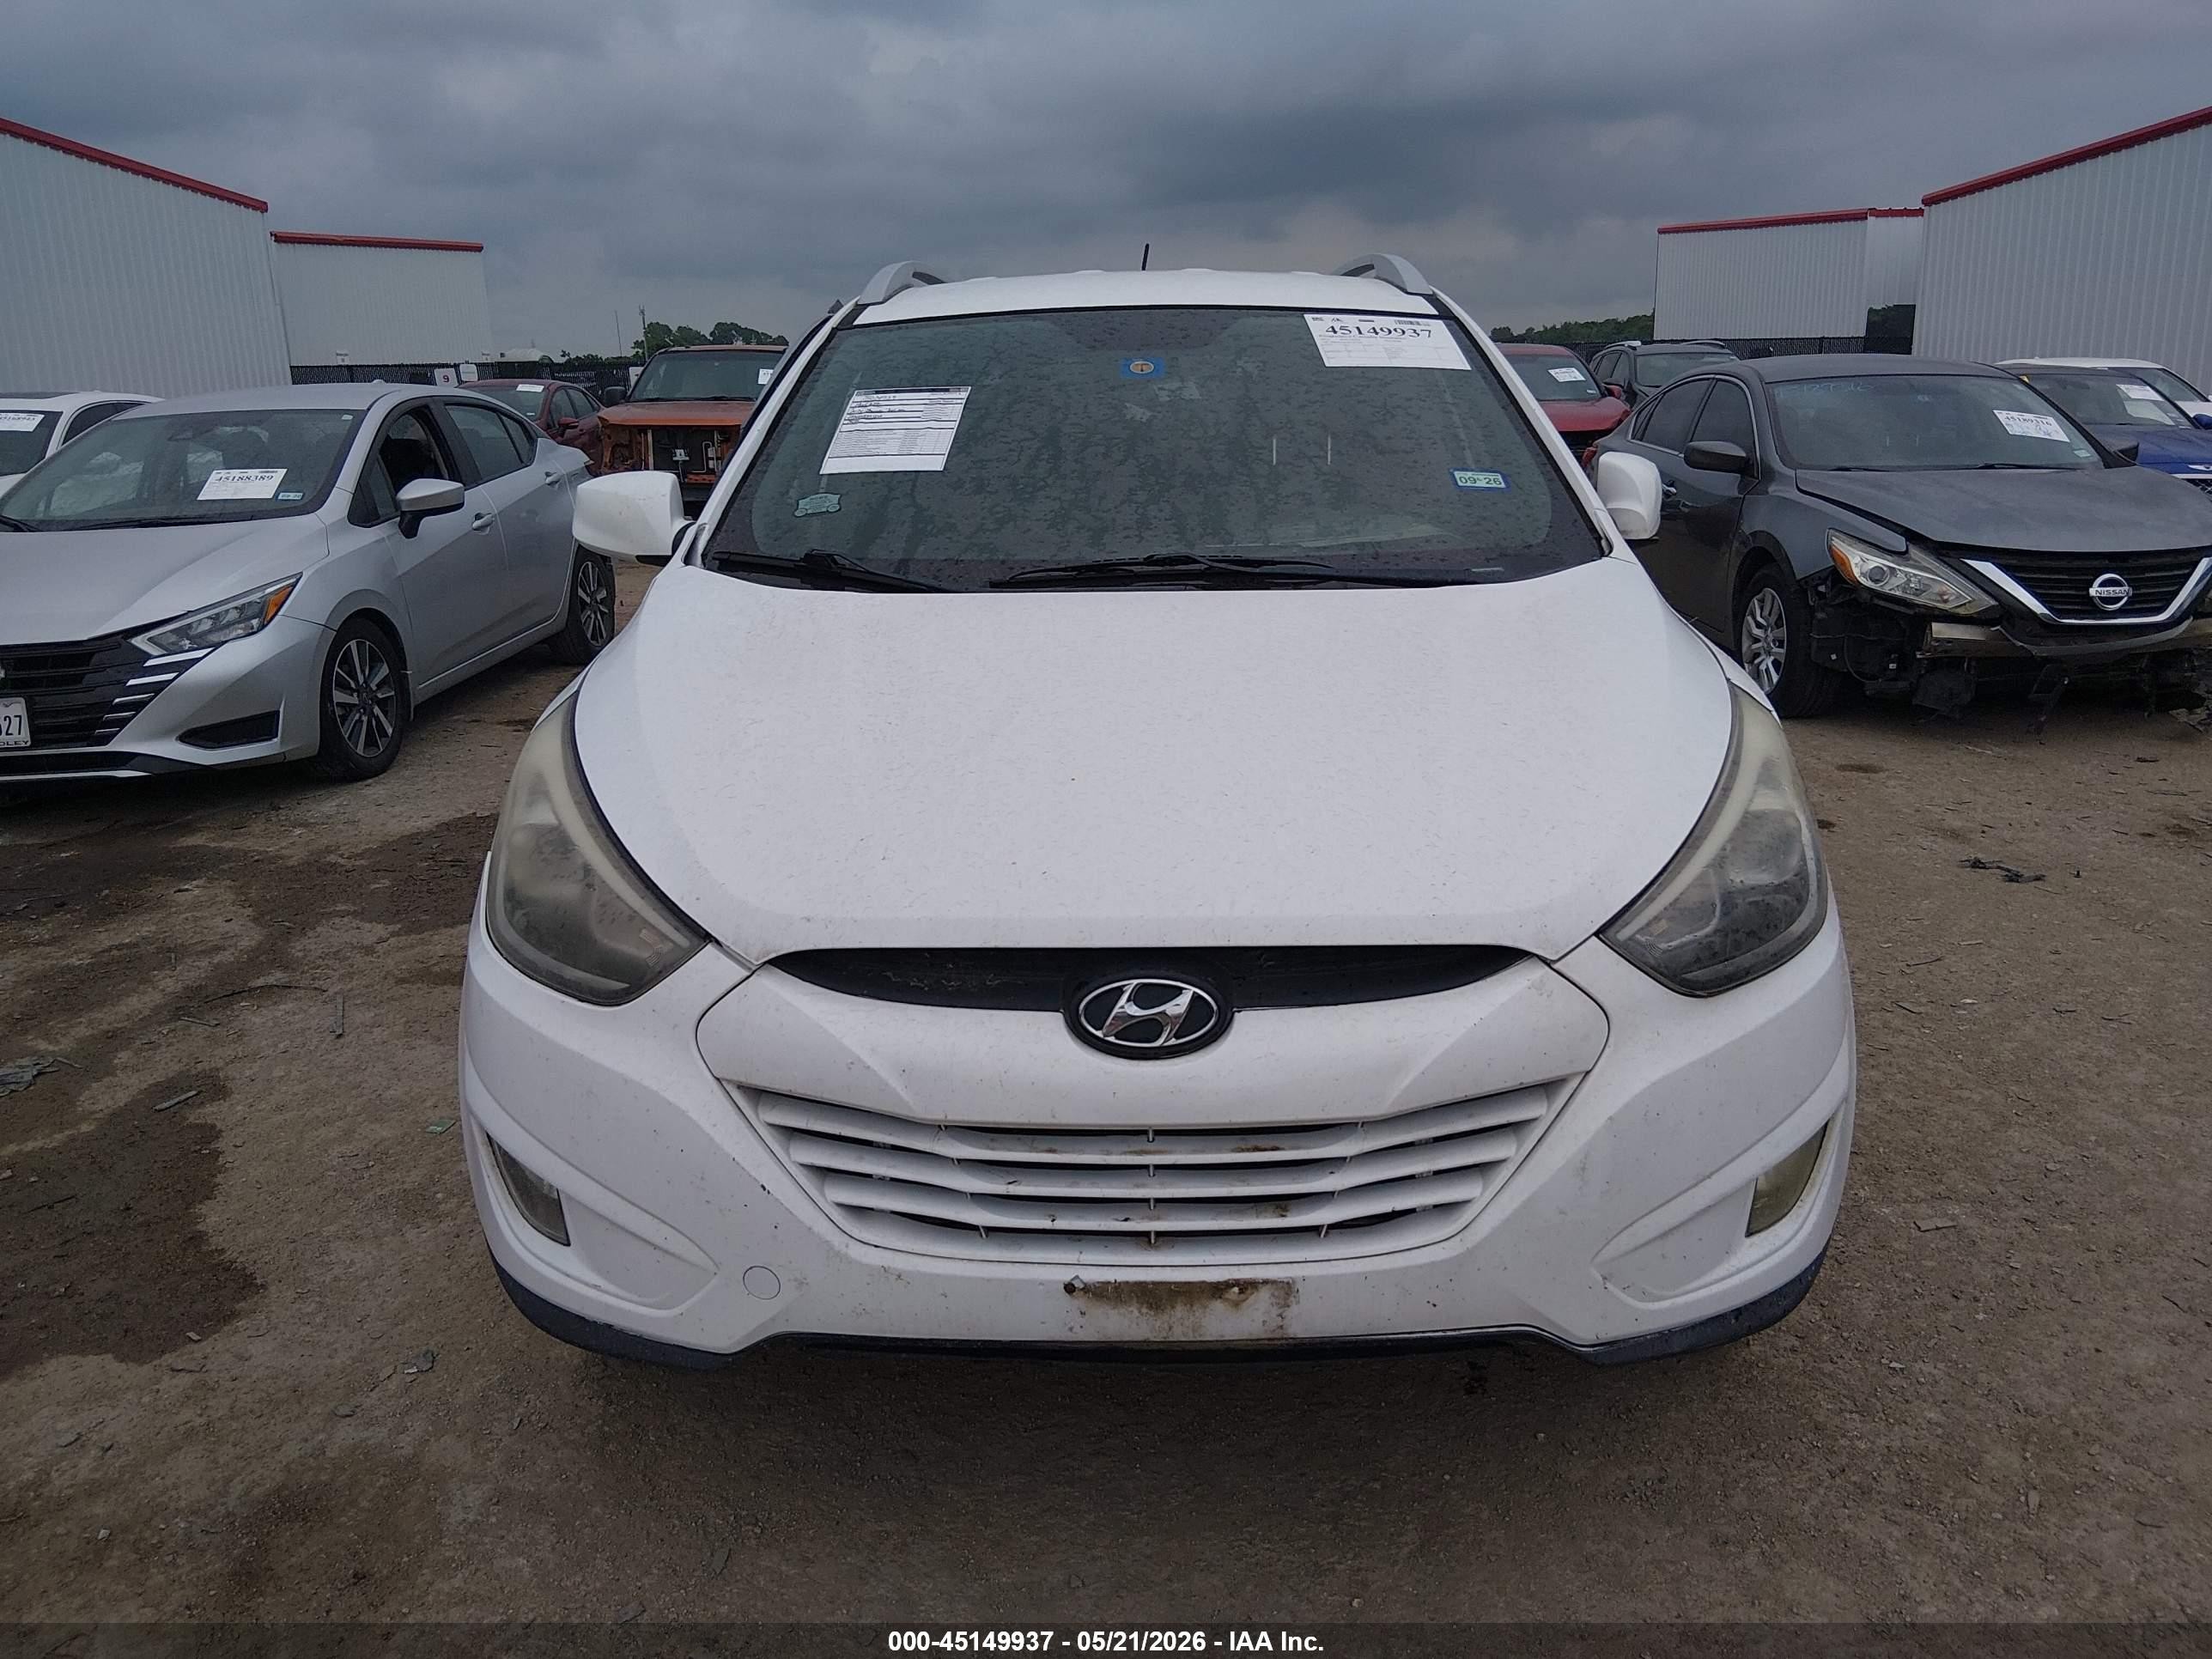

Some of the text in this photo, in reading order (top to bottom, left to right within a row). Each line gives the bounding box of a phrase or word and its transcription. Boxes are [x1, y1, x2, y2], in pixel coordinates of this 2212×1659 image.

[1325, 325, 1431, 338] 45149937
[442, 374, 450, 383] 9
[0, 714, 22, 736] 27
